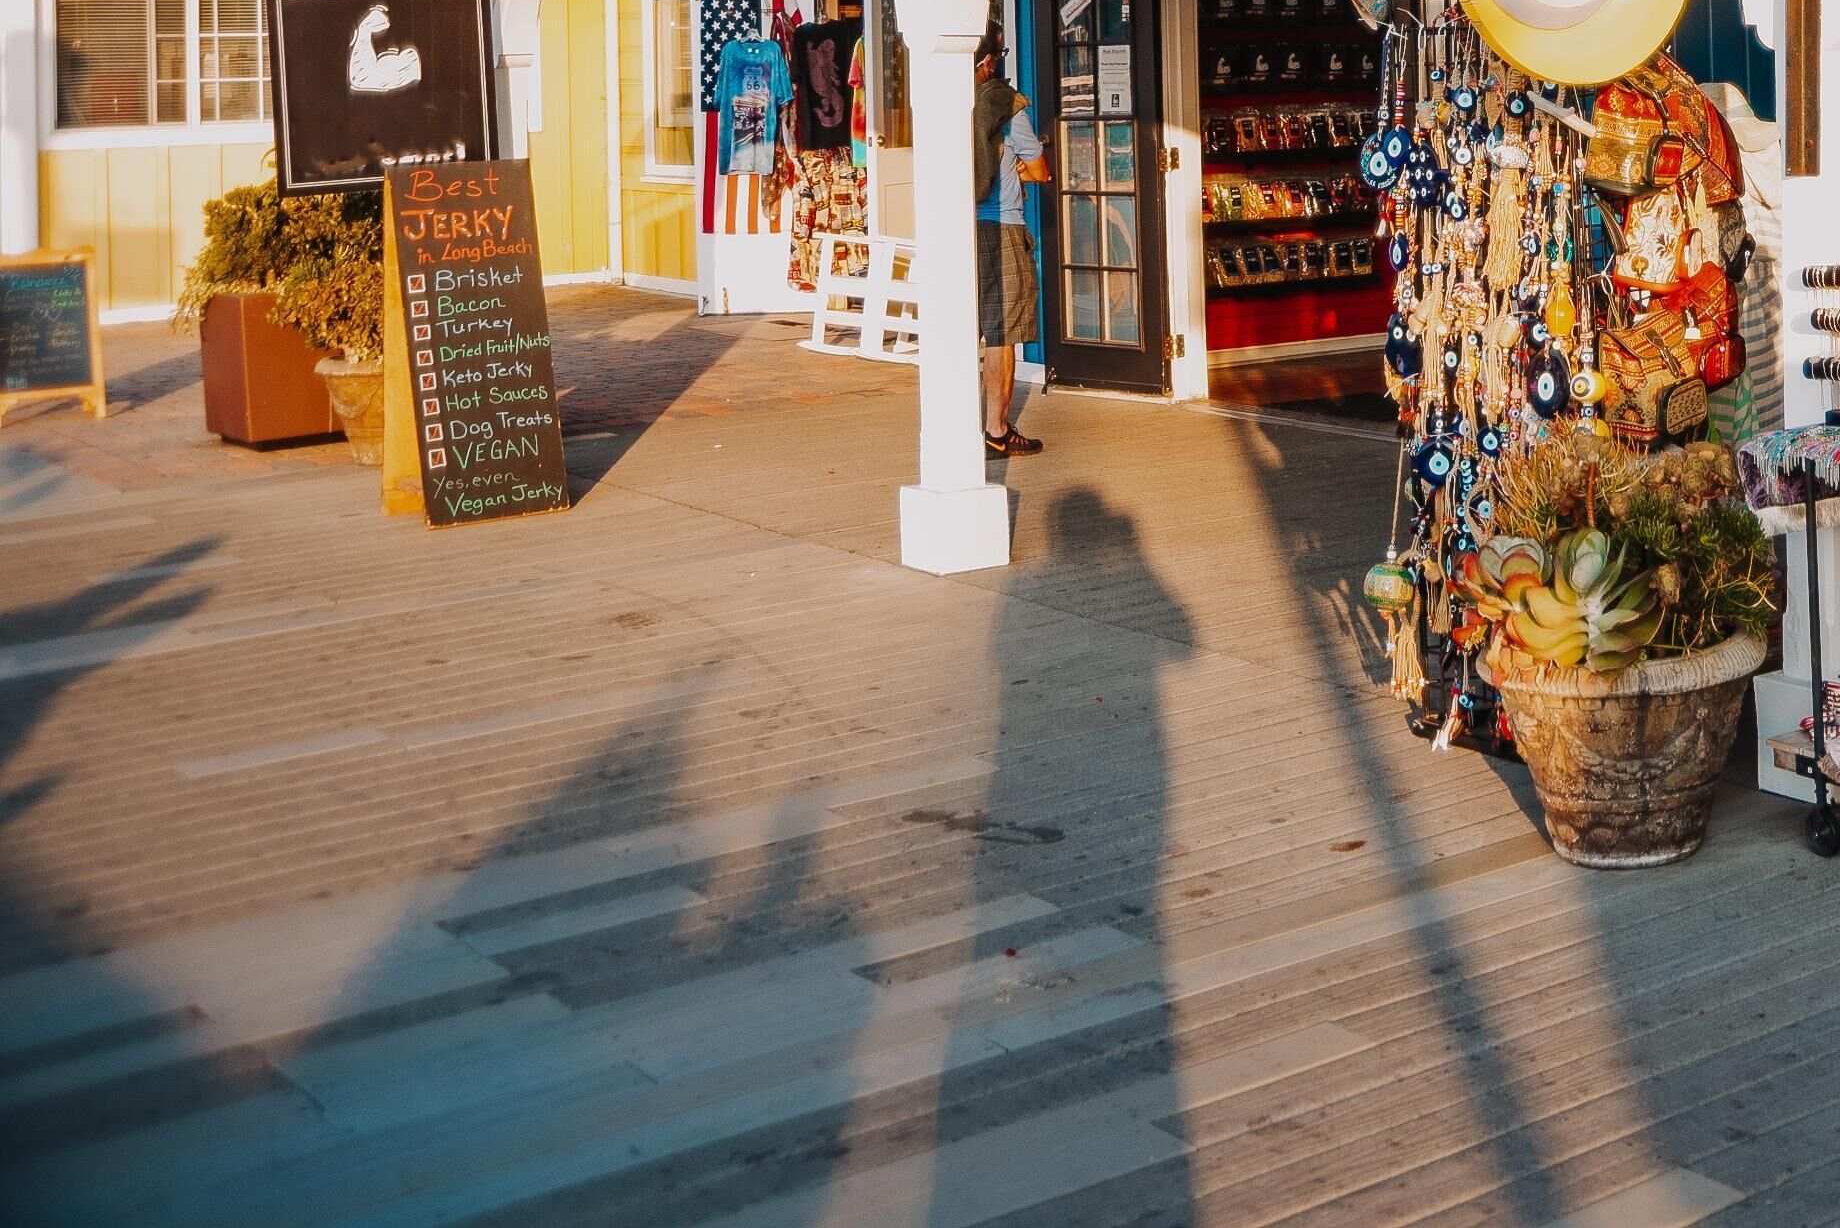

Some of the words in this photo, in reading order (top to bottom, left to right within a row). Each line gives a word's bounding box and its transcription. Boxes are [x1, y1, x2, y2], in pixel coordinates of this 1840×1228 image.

[746, 80, 760, 91] 66
[404, 167, 500, 202] Best
[401, 205, 513, 241] JERKY
[417, 248, 436, 265] in
[441, 242, 480, 263] Long
[482, 237, 533, 258] Beach
[435, 265, 523, 291] Brisket
[437, 295, 506, 317] Bacon
[436, 317, 513, 338] Turkey
[439, 342, 482, 362] Dried
[486, 333, 551, 356] Fruit/Nuts
[442, 369, 482, 388] Keto
[486, 361, 533, 379] Jerky
[446, 390, 481, 412] Hot
[489, 385, 548, 405] Sauces
[450, 420, 494, 440] Dog
[496, 411, 553, 429] Treats
[452, 433, 539, 469] VEGAN
[472, 471, 520, 487] even
[445, 492, 507, 517] Vegan
[512, 481, 563, 501] Jerky
